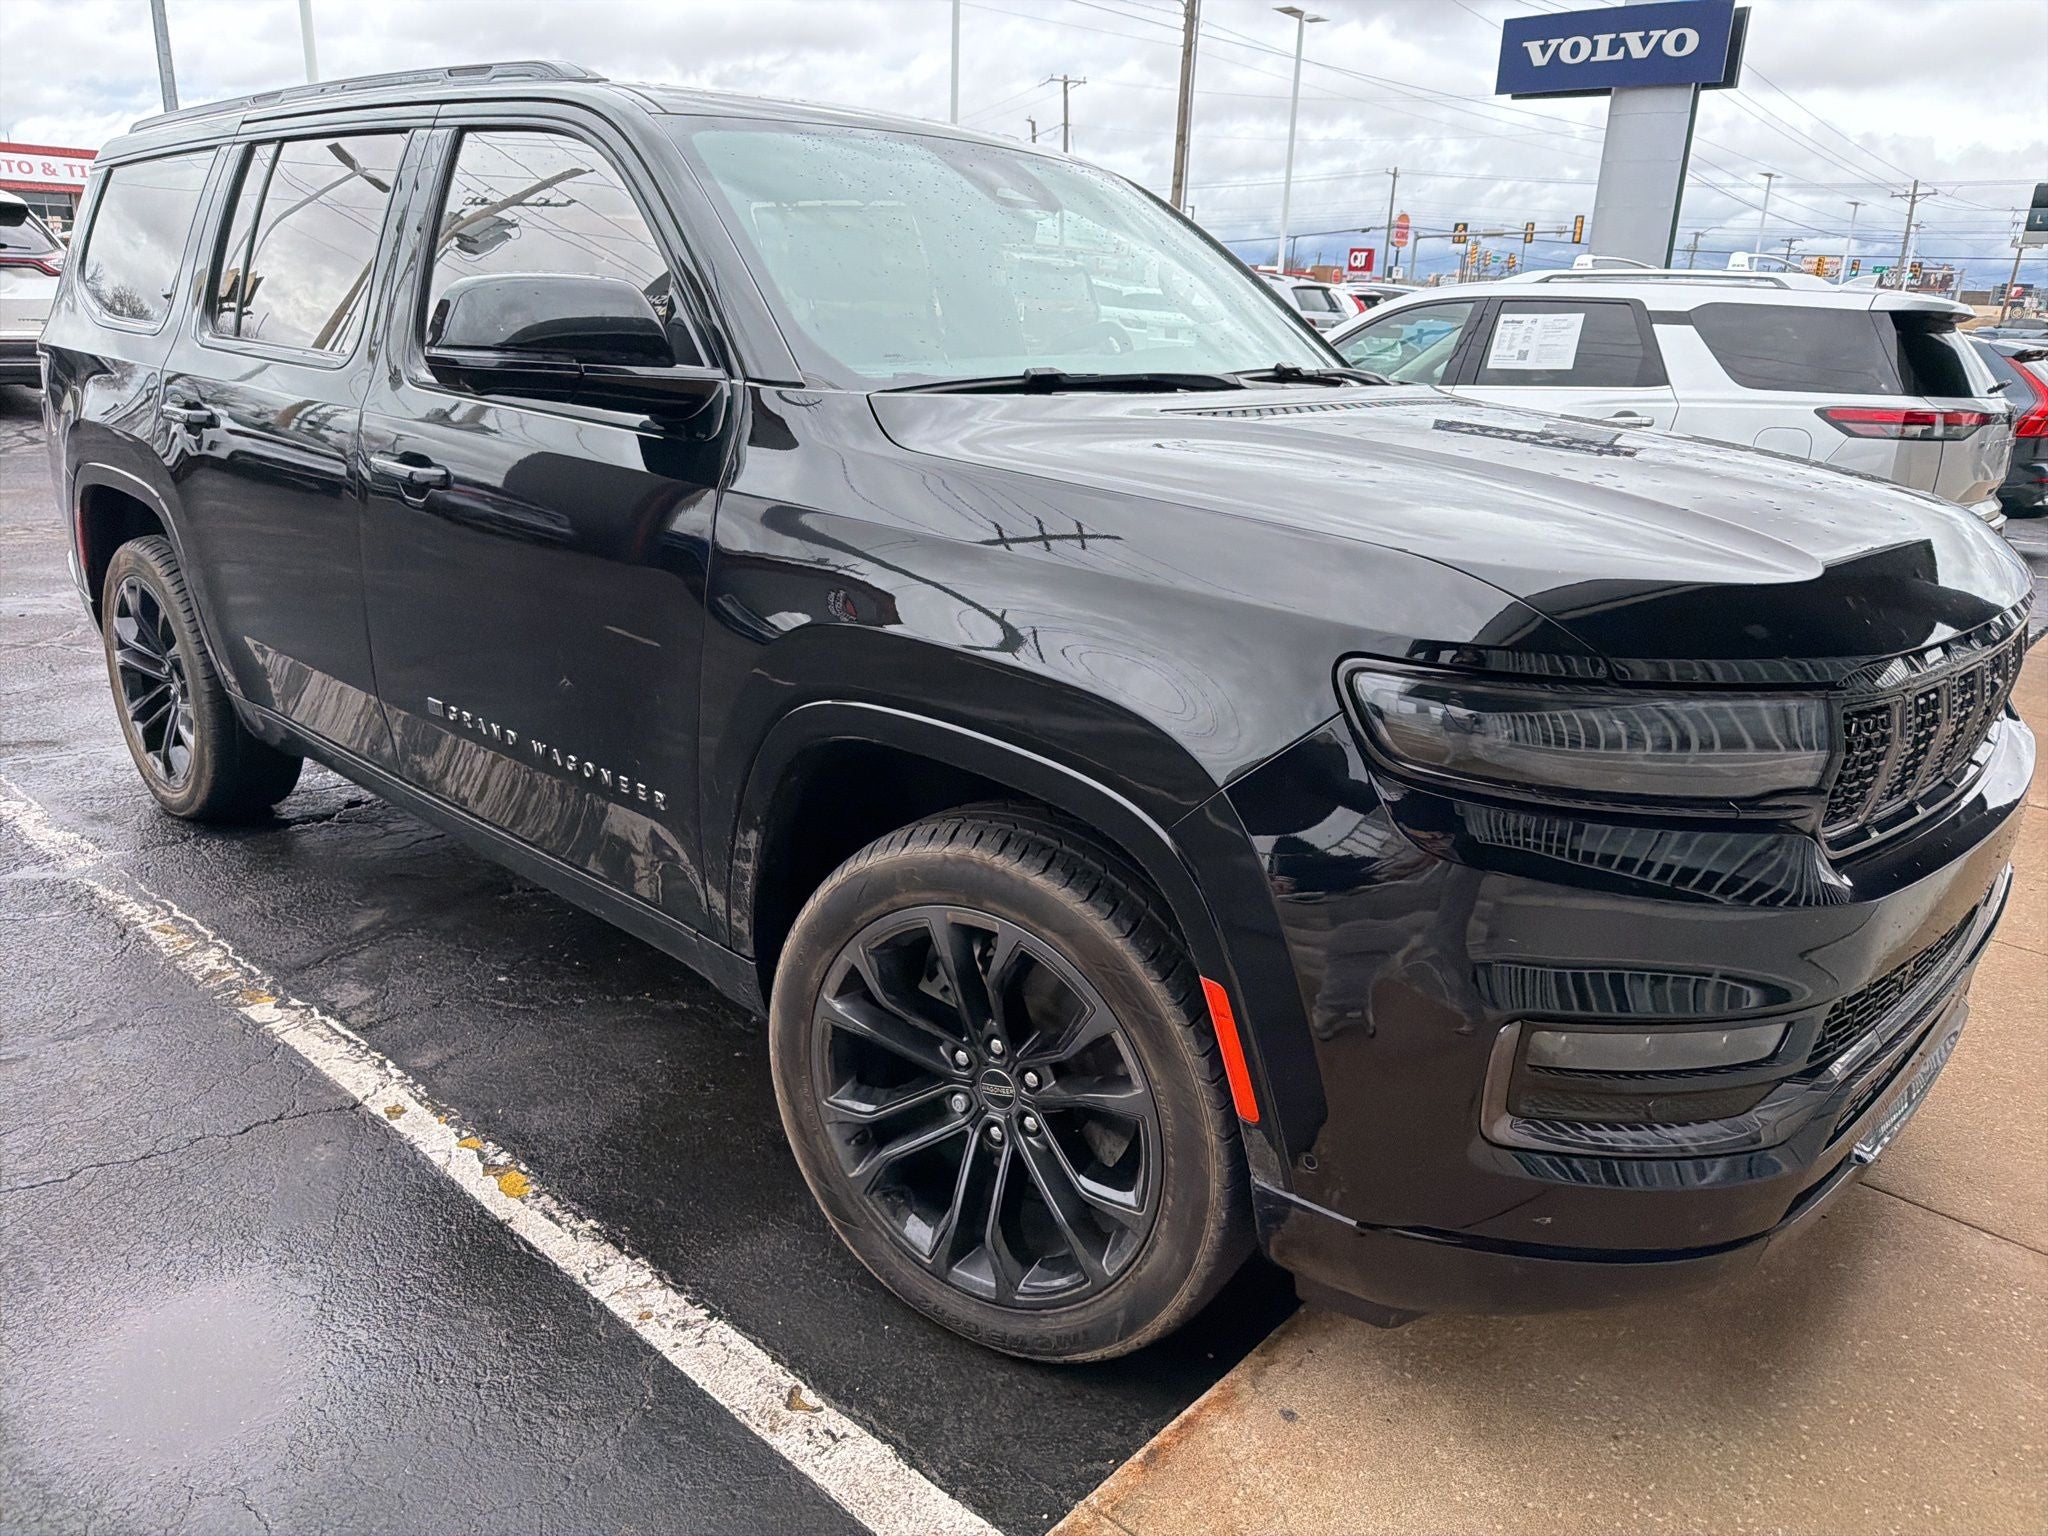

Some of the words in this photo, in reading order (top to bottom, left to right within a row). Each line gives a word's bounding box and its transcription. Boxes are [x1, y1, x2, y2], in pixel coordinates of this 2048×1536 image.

[1522, 28, 1700, 67] VOLVO
[0, 160, 34, 175] TO
[41, 162, 59, 177] &
[1350, 251, 1368, 268] QT
[448, 705, 519, 746] GRAND
[531, 739, 667, 811] WAGONEER
